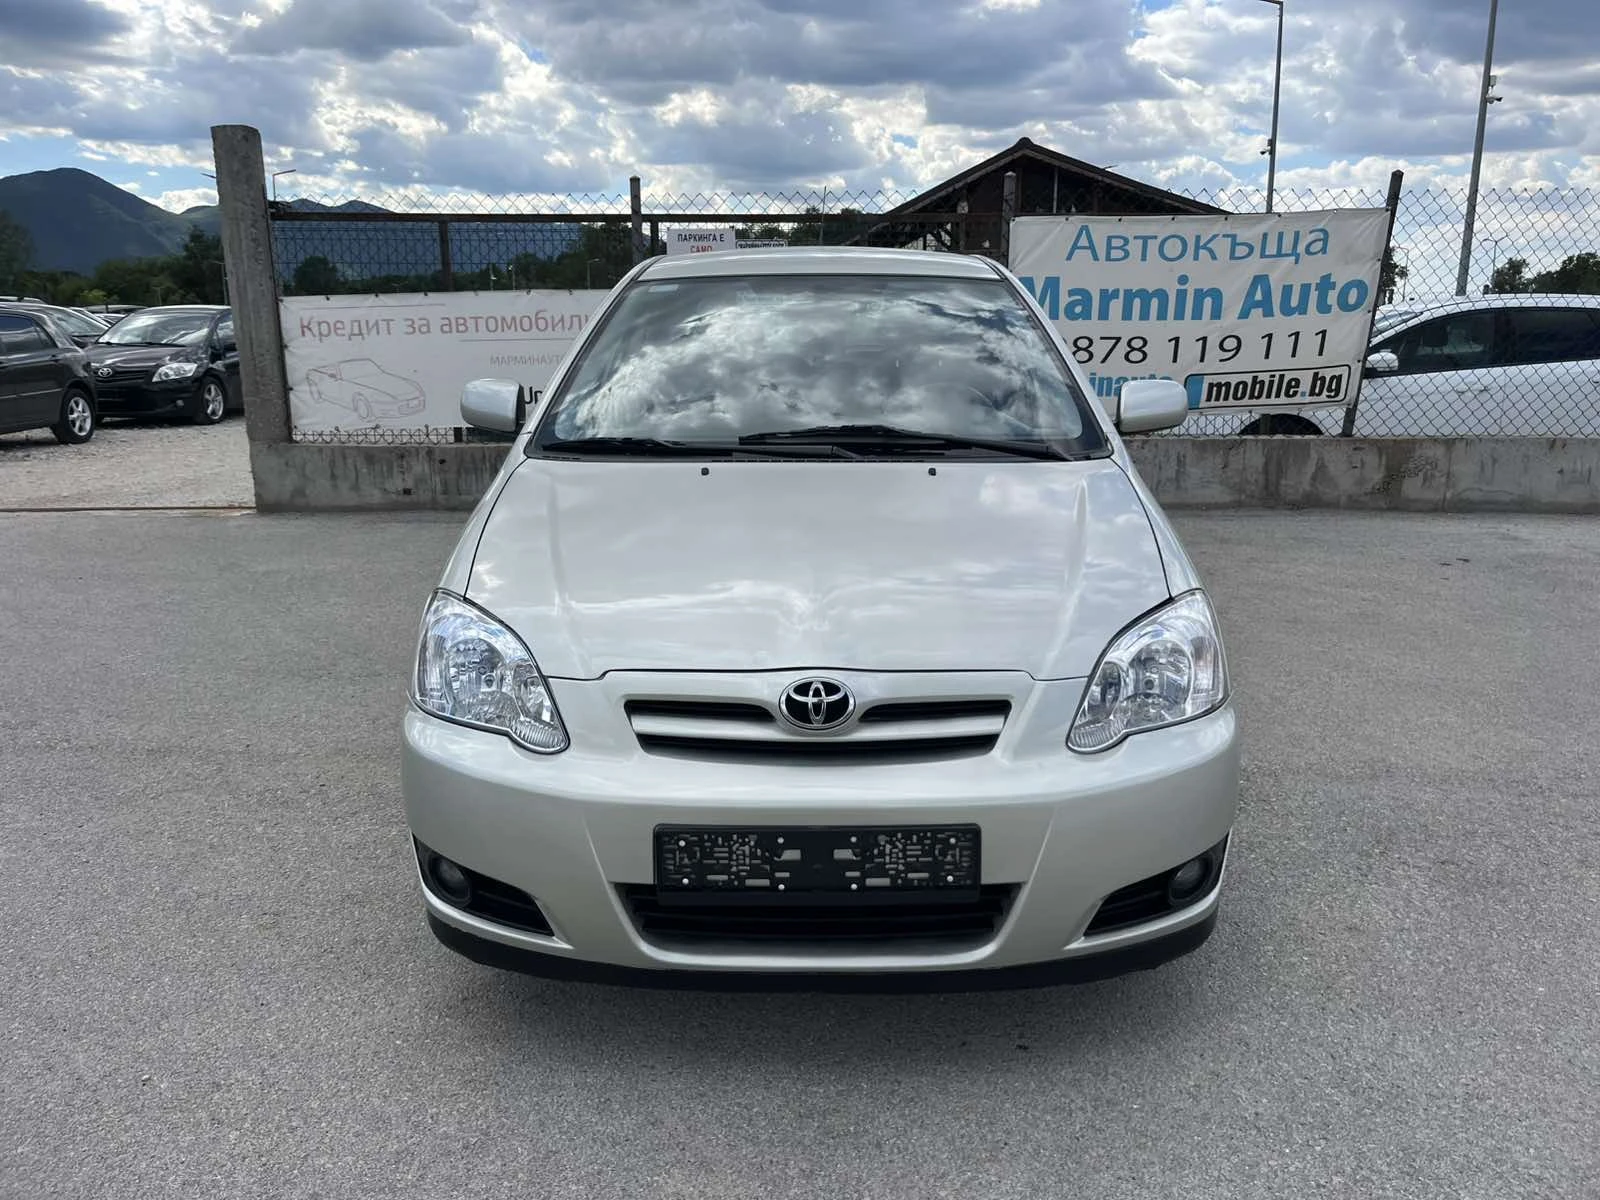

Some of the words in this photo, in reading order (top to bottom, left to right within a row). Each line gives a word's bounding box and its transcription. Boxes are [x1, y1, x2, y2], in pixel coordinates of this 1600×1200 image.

[677, 233, 717, 242] ПАРКИНГА
[720, 233, 725, 242] Е
[1065, 225, 1330, 264] Автокъща
[1018, 274, 1223, 321] Marmin
[1237, 272, 1369, 321] Auto
[300, 317, 396, 342] Кредит
[404, 317, 431, 335] за
[1063, 335, 1148, 364] 878
[1168, 334, 1242, 364] 119
[1261, 329, 1328, 359] 111
[1205, 371, 1343, 402] mobile.bg
